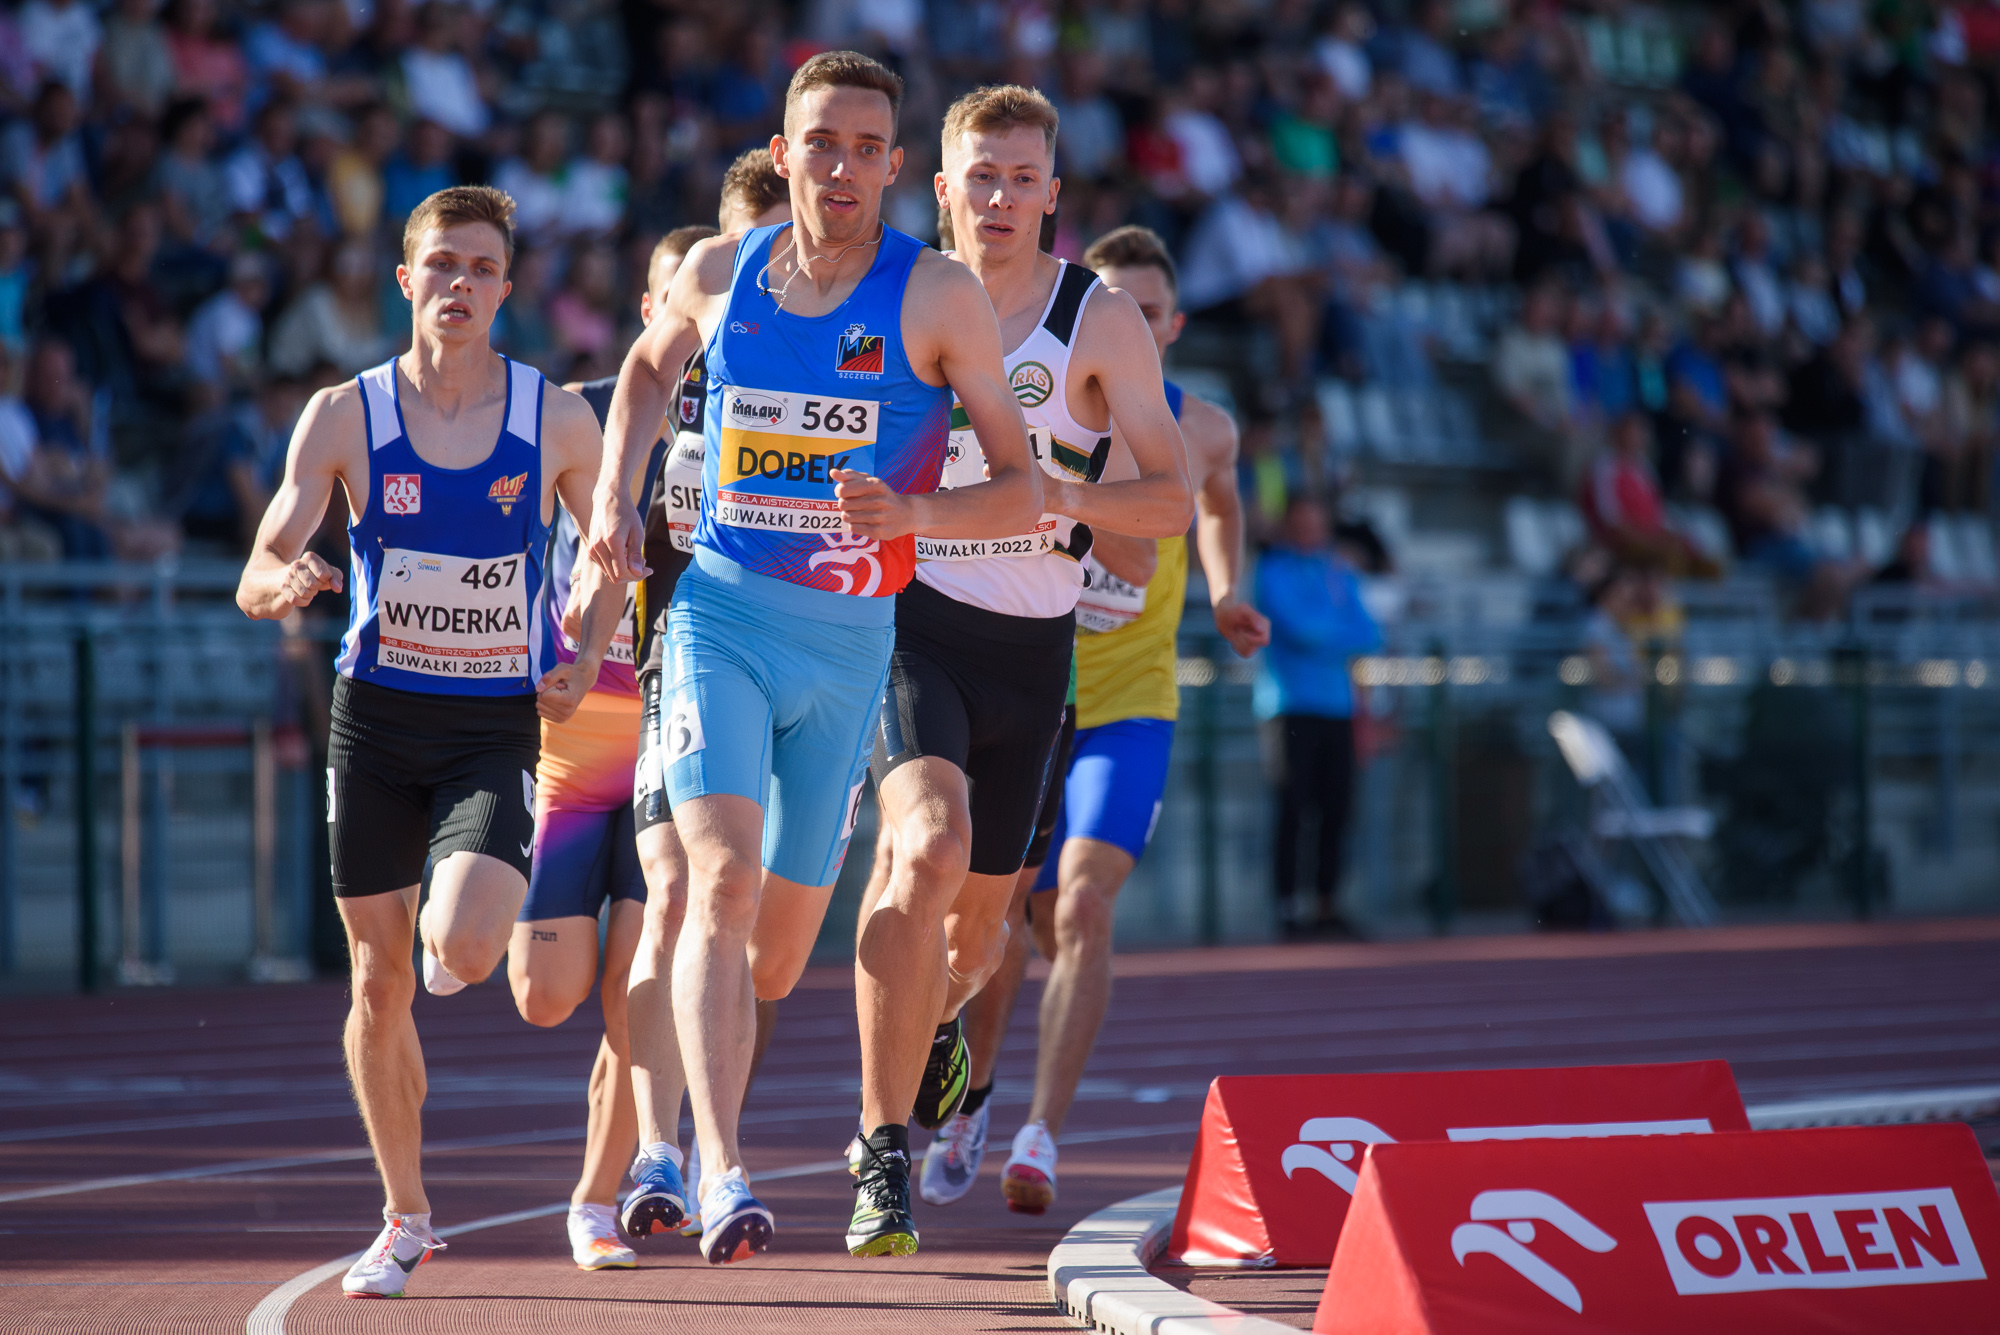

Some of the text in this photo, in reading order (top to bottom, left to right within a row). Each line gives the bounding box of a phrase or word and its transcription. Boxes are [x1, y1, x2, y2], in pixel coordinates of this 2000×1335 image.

[838, 372, 880, 380] SZCZECIN
[1015, 368, 1047, 387] RKS
[732, 402, 782, 419] MALOW
[800, 400, 868, 434] 563
[737, 446, 850, 484] DOBEK
[488, 472, 528, 496] AWF
[722, 492, 734, 501] 98.
[735, 495, 758, 504] PZLA
[759, 498, 830, 510] MISTRZOSTWA
[722, 506, 842, 529] SUWAŁKI 2022
[918, 540, 1032, 557] SUWAŁKI 2022
[460, 559, 518, 590] 467
[385, 600, 522, 634] WYDERKA
[401, 641, 423, 652] PZLA
[424, 645, 490, 656] MISTRZOSTWA
[492, 647, 523, 655] POLSKI
[386, 651, 502, 673] SUWAŁKI 2022
[532, 930, 557, 942] run
[1676, 1204, 1960, 1279] ORLEN
